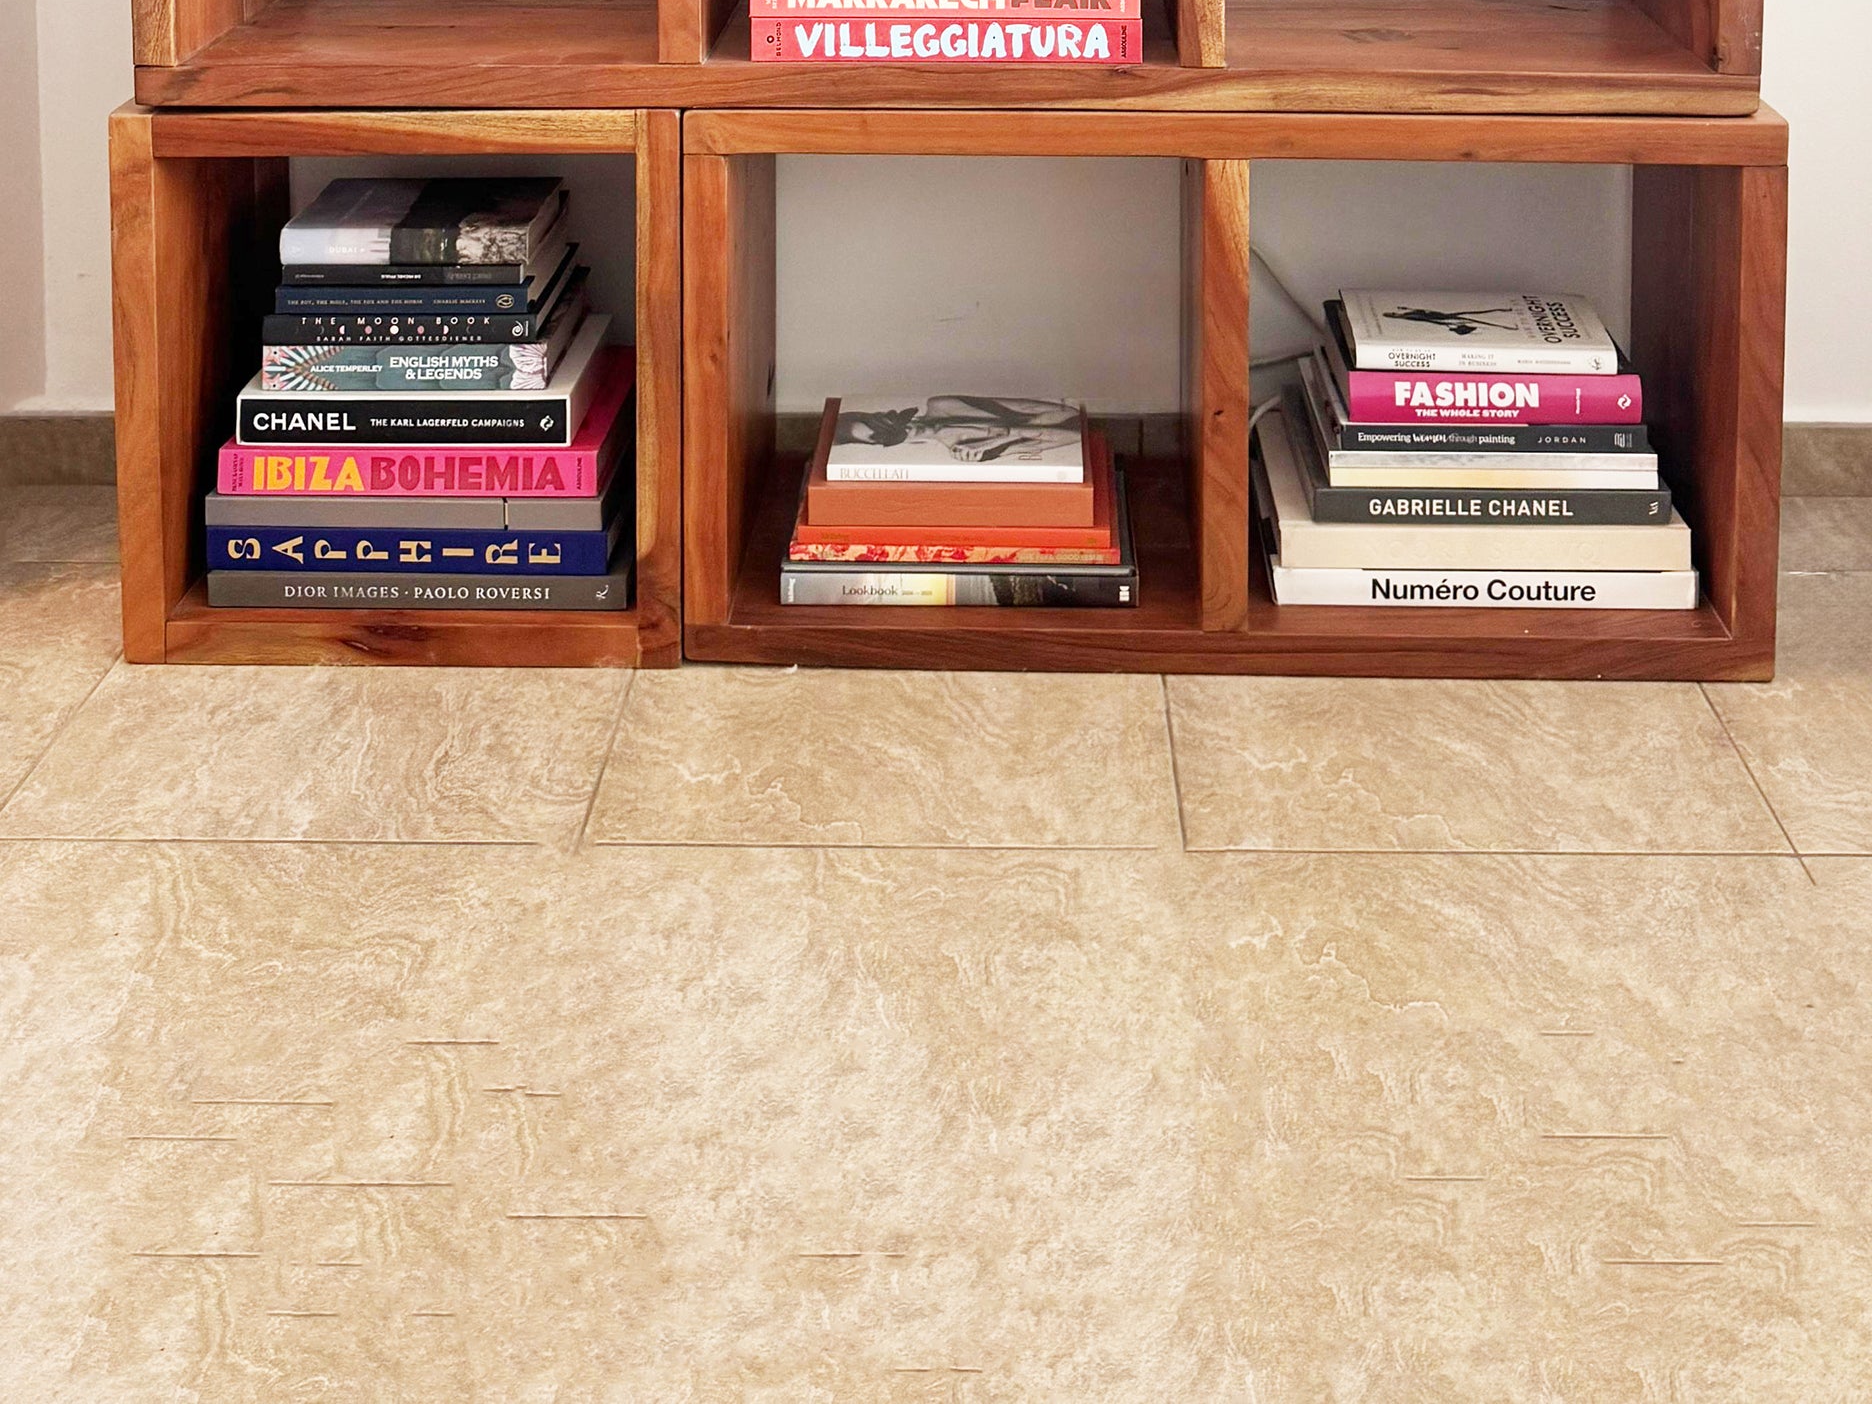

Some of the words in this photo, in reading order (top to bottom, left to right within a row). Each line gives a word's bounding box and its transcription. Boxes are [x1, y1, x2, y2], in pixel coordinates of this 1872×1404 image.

[794, 21, 1111, 59] VILLEGGIATURA
[302, 317, 337, 325] THE
[357, 317, 415, 325] MOON
[435, 317, 490, 325] BOOK
[1522, 295, 1562, 344] OVERNIGHT
[1546, 302, 1581, 339] SUCCESS
[389, 356, 449, 368] ENGLISH
[451, 356, 499, 368] MYTHS
[1387, 352, 1436, 361] OVERNIGHT
[310, 365, 336, 373] ALICE
[336, 365, 383, 373] TEMPERLEY
[1395, 381, 1540, 408] FASHION
[1415, 408, 1437, 417] THE
[1439, 409, 1480, 417] WHOLE
[1482, 409, 1519, 418] STORY
[253, 412, 357, 431] CHANEL
[370, 418, 388, 427] THE
[390, 418, 415, 427] KARL
[416, 418, 469, 427] LAGERFELD
[471, 418, 526, 428] CAMPAIGNS
[1358, 432, 1411, 444] Empowering
[1478, 434, 1516, 445] painting
[1537, 436, 1587, 444] JORDAN
[253, 455, 366, 491] IBIZA
[370, 455, 566, 491] BOHEMIA
[1369, 499, 1482, 516] GABRIELLE
[1488, 500, 1573, 517] CHANEL
[227, 535, 561, 565] SAPPHIRE
[284, 586, 328, 598] DIOR
[333, 586, 400, 598] IMAGES
[414, 587, 470, 600] PAOLO
[476, 587, 551, 600] ROVERSI
[842, 584, 898, 596] Lookbook
[1371, 578, 1480, 601] Numéro
[1486, 579, 1597, 602] Couture
